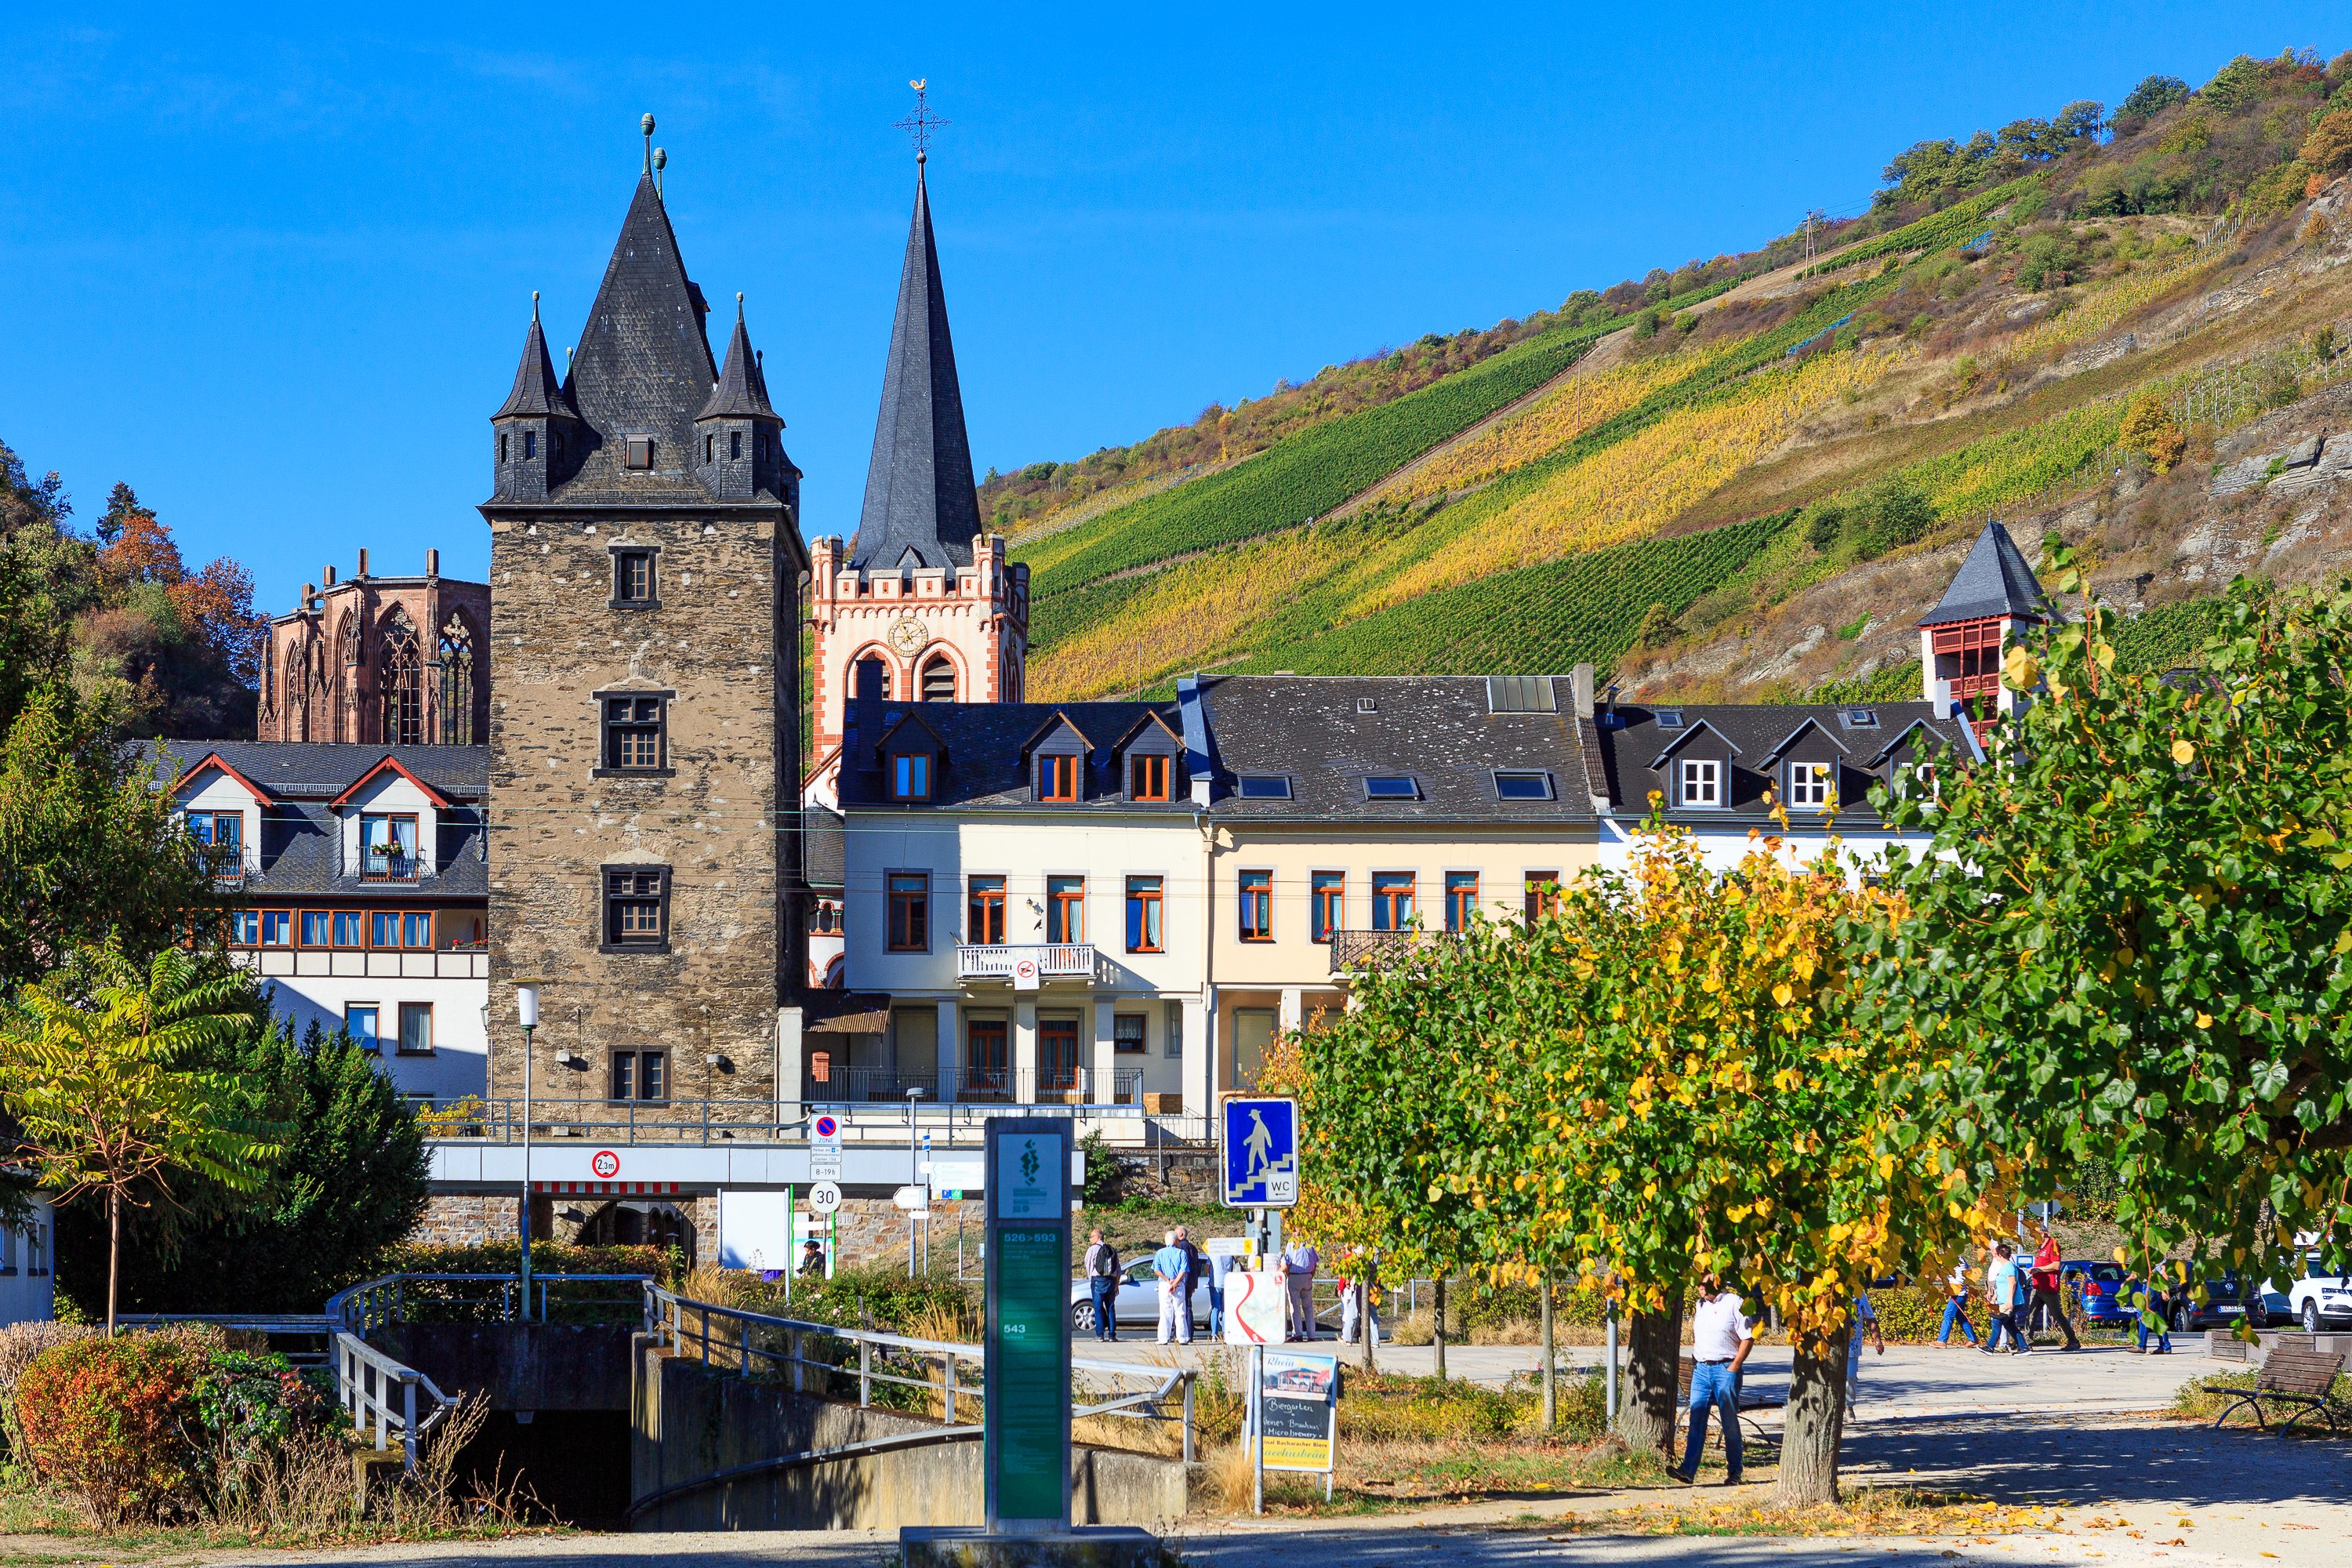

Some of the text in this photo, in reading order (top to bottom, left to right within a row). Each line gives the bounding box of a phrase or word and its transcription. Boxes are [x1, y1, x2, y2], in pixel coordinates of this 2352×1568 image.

[1271, 1181, 1290, 1192] WC
[816, 1190, 834, 1204] 30
[1004, 1323, 1026, 1334] 543
[1267, 1356, 1294, 1367] Rhein
[1265, 1397, 1314, 1414] Biergarten
[1288, 1418, 1319, 1430] Brauhaus
[1263, 1448, 1327, 1460] acchusbräu
